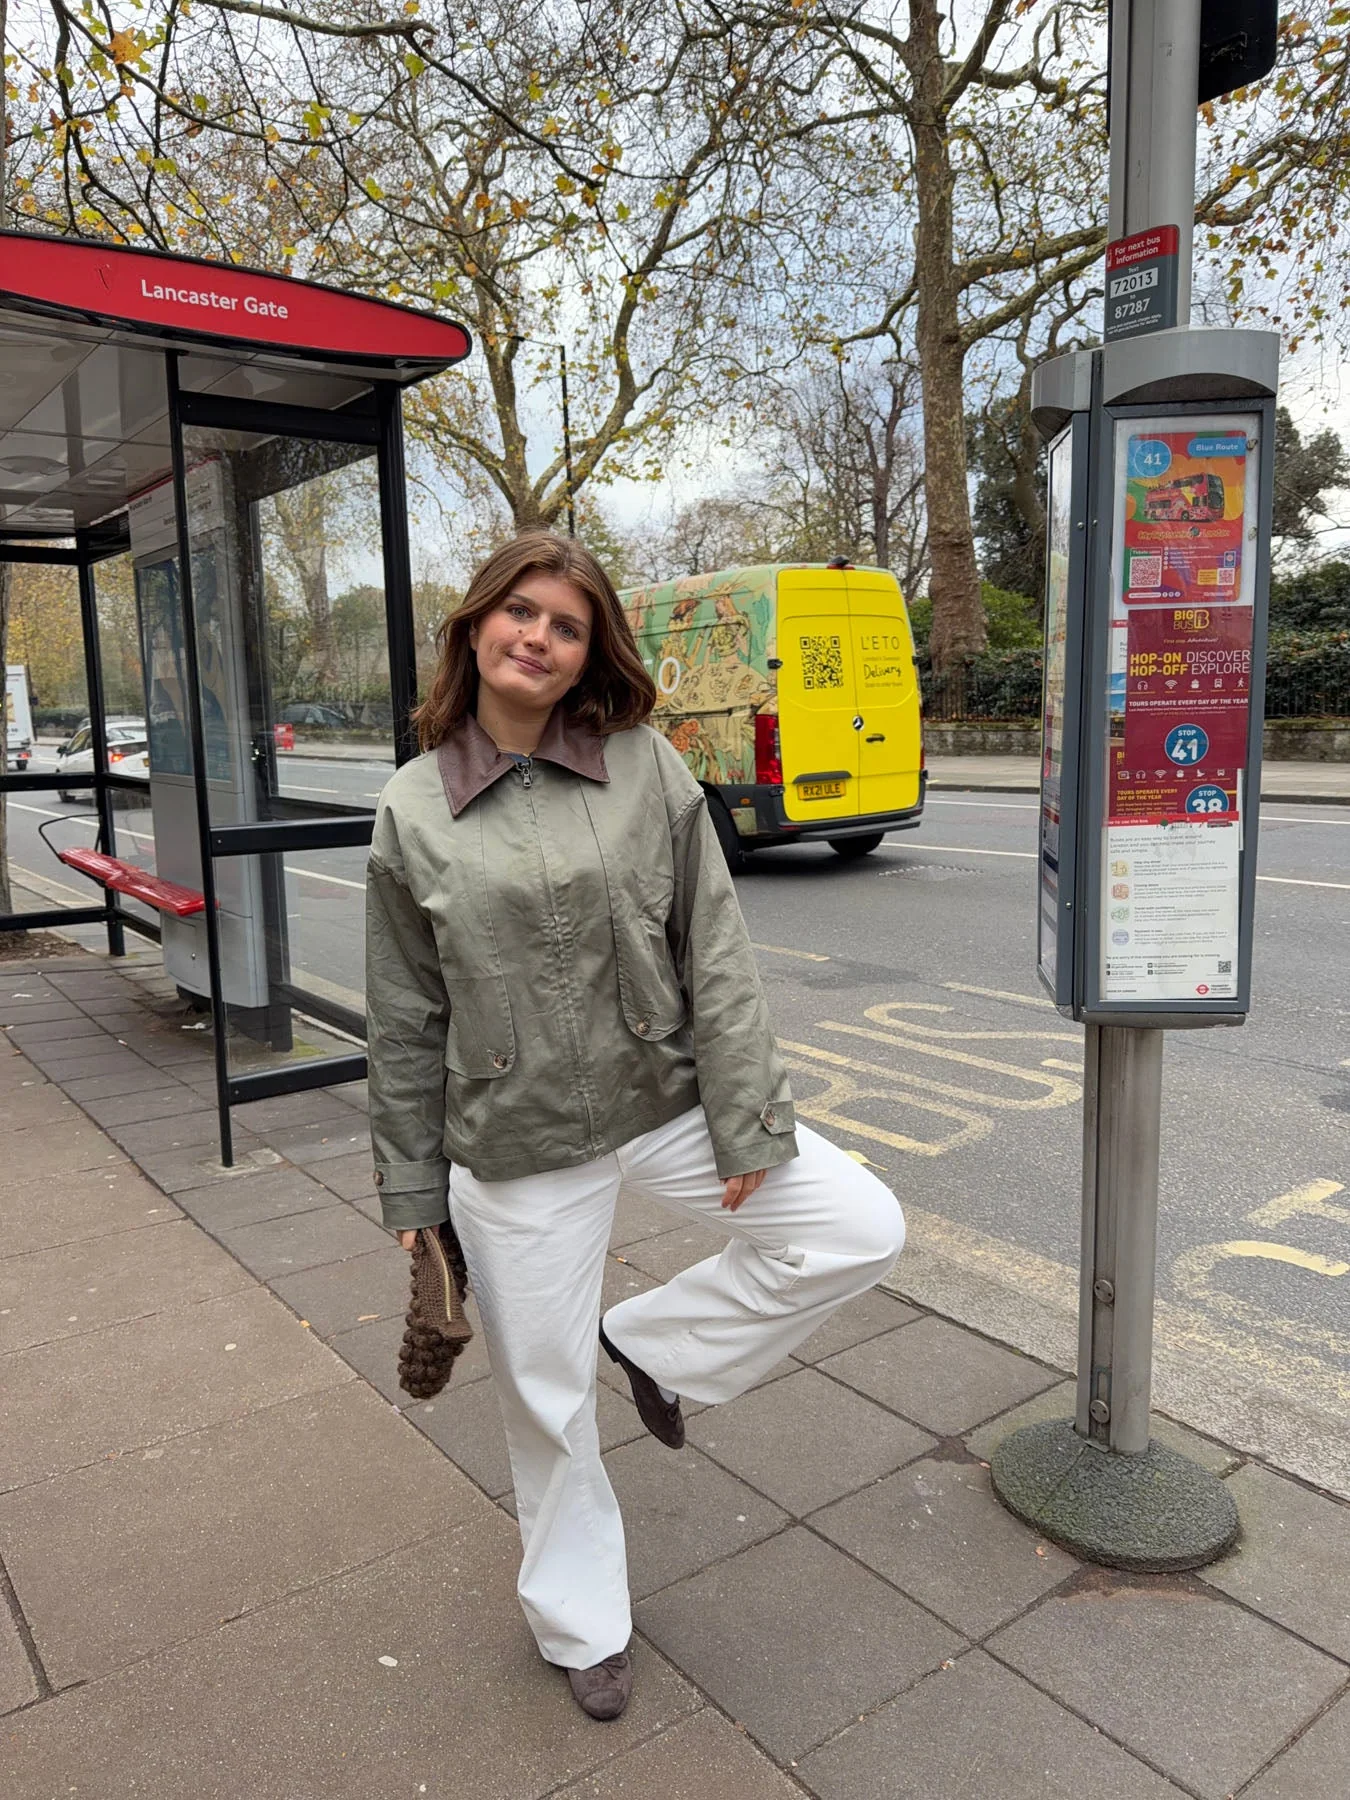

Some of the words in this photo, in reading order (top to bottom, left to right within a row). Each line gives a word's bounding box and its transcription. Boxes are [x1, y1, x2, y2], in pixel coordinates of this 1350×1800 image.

[1115, 246, 1126, 256] For
[1128, 241, 1145, 252] next
[1146, 236, 1160, 246] bus
[1116, 246, 1158, 264] information
[1114, 272, 1152, 295] 72013
[141, 279, 238, 310] Lancaster
[244, 297, 288, 319] Gate
[1114, 298, 1151, 319] 87287
[1144, 453, 1162, 465] 41
[1174, 610, 1194, 621] BIG
[1174, 621, 1193, 630] BUS
[1130, 652, 1182, 665] HOP-ON
[1186, 650, 1250, 662] DISCOVER
[864, 664, 901, 680] Delivery
[1130, 664, 1188, 676] HOP-OFF
[1191, 662, 1250, 675] EXPLORE
[1171, 738, 1198, 761] 41
[824, 783, 840, 794] ULE
